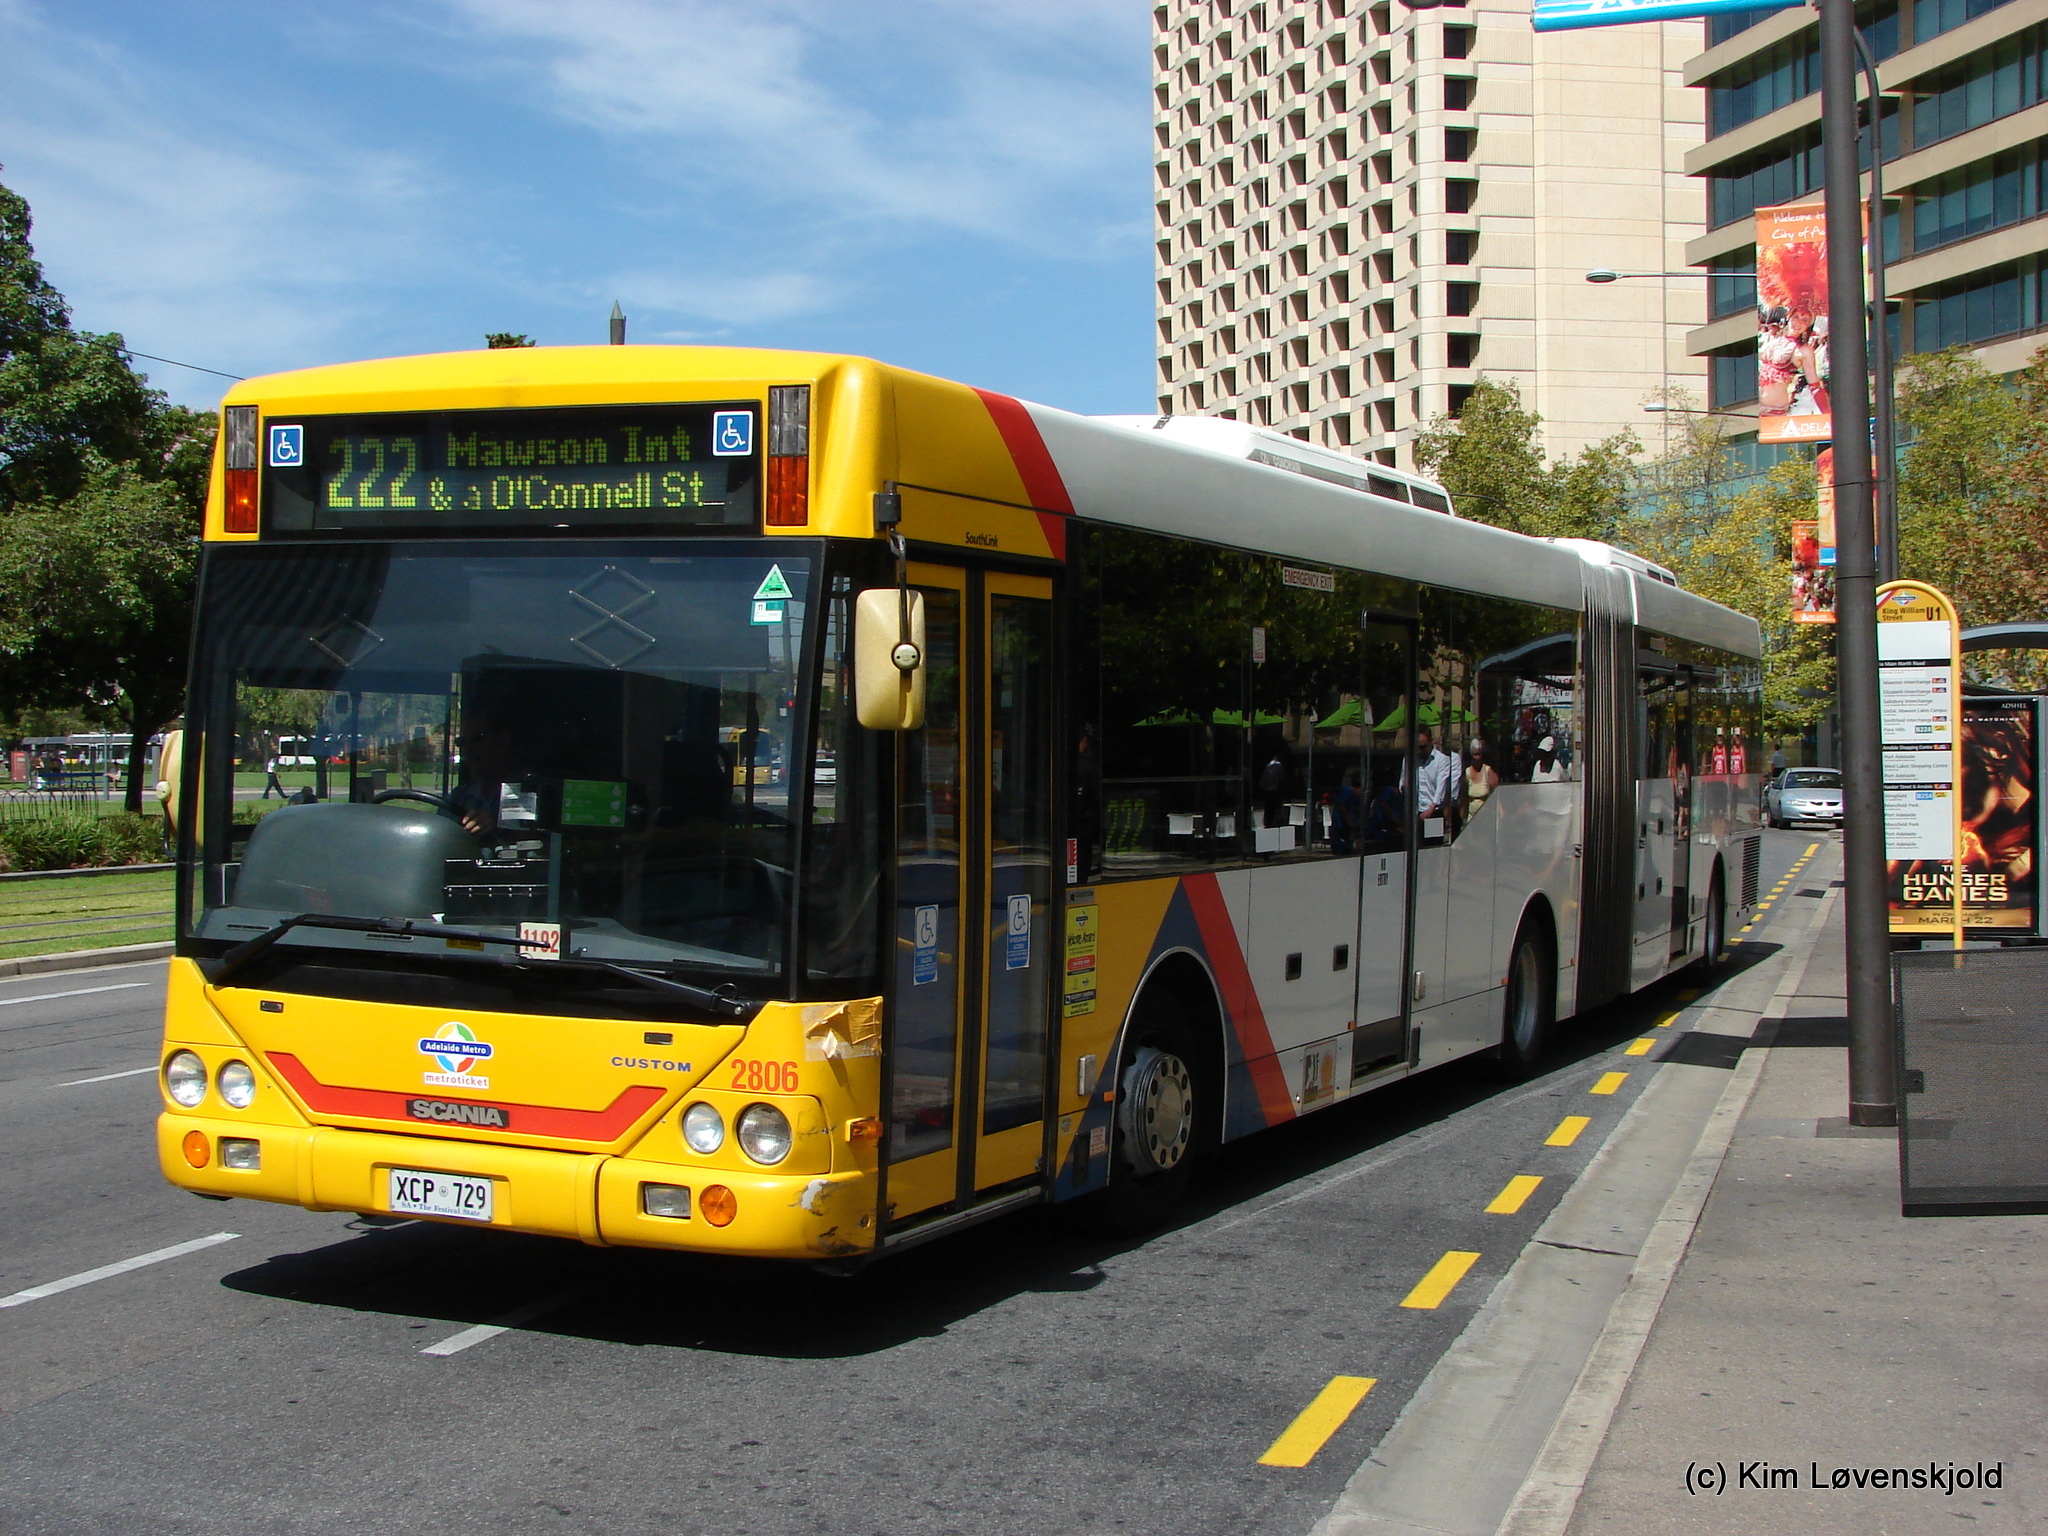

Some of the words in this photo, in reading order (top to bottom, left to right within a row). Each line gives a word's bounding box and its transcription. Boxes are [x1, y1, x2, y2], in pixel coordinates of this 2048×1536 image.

[1773, 211, 1812, 224] Welcome
[1771, 228, 1795, 242] City
[1797, 226, 1810, 239] of
[447, 431, 608, 468] Mawson
[620, 425, 691, 462] Int
[328, 438, 417, 508] 222
[430, 476, 453, 511] &
[491, 471, 652, 511] O'Connell
[661, 470, 704, 508] St
[965, 531, 999, 548] SouthLink
[1284, 569, 1320, 587] EMERGENCY
[1320, 575, 1333, 590] EXIT
[1899, 606, 1926, 614] William
[1926, 606, 1941, 621] U1
[1903, 873, 2006, 886] HUNGER
[425, 1041, 461, 1053] Adelaide
[462, 1044, 487, 1055] Metro
[425, 1074, 488, 1087] metroticket
[611, 1056, 692, 1073] CUSTOM
[731, 1058, 799, 1093] 2806
[412, 1099, 504, 1127] SCANIA
[396, 1175, 436, 1204] XCP
[452, 1182, 486, 1210] 729
[401, 1201, 412, 1209] SA
[416, 1203, 432, 1211] The
[434, 1204, 461, 1215] Festival
[462, 1208, 480, 1217] State
